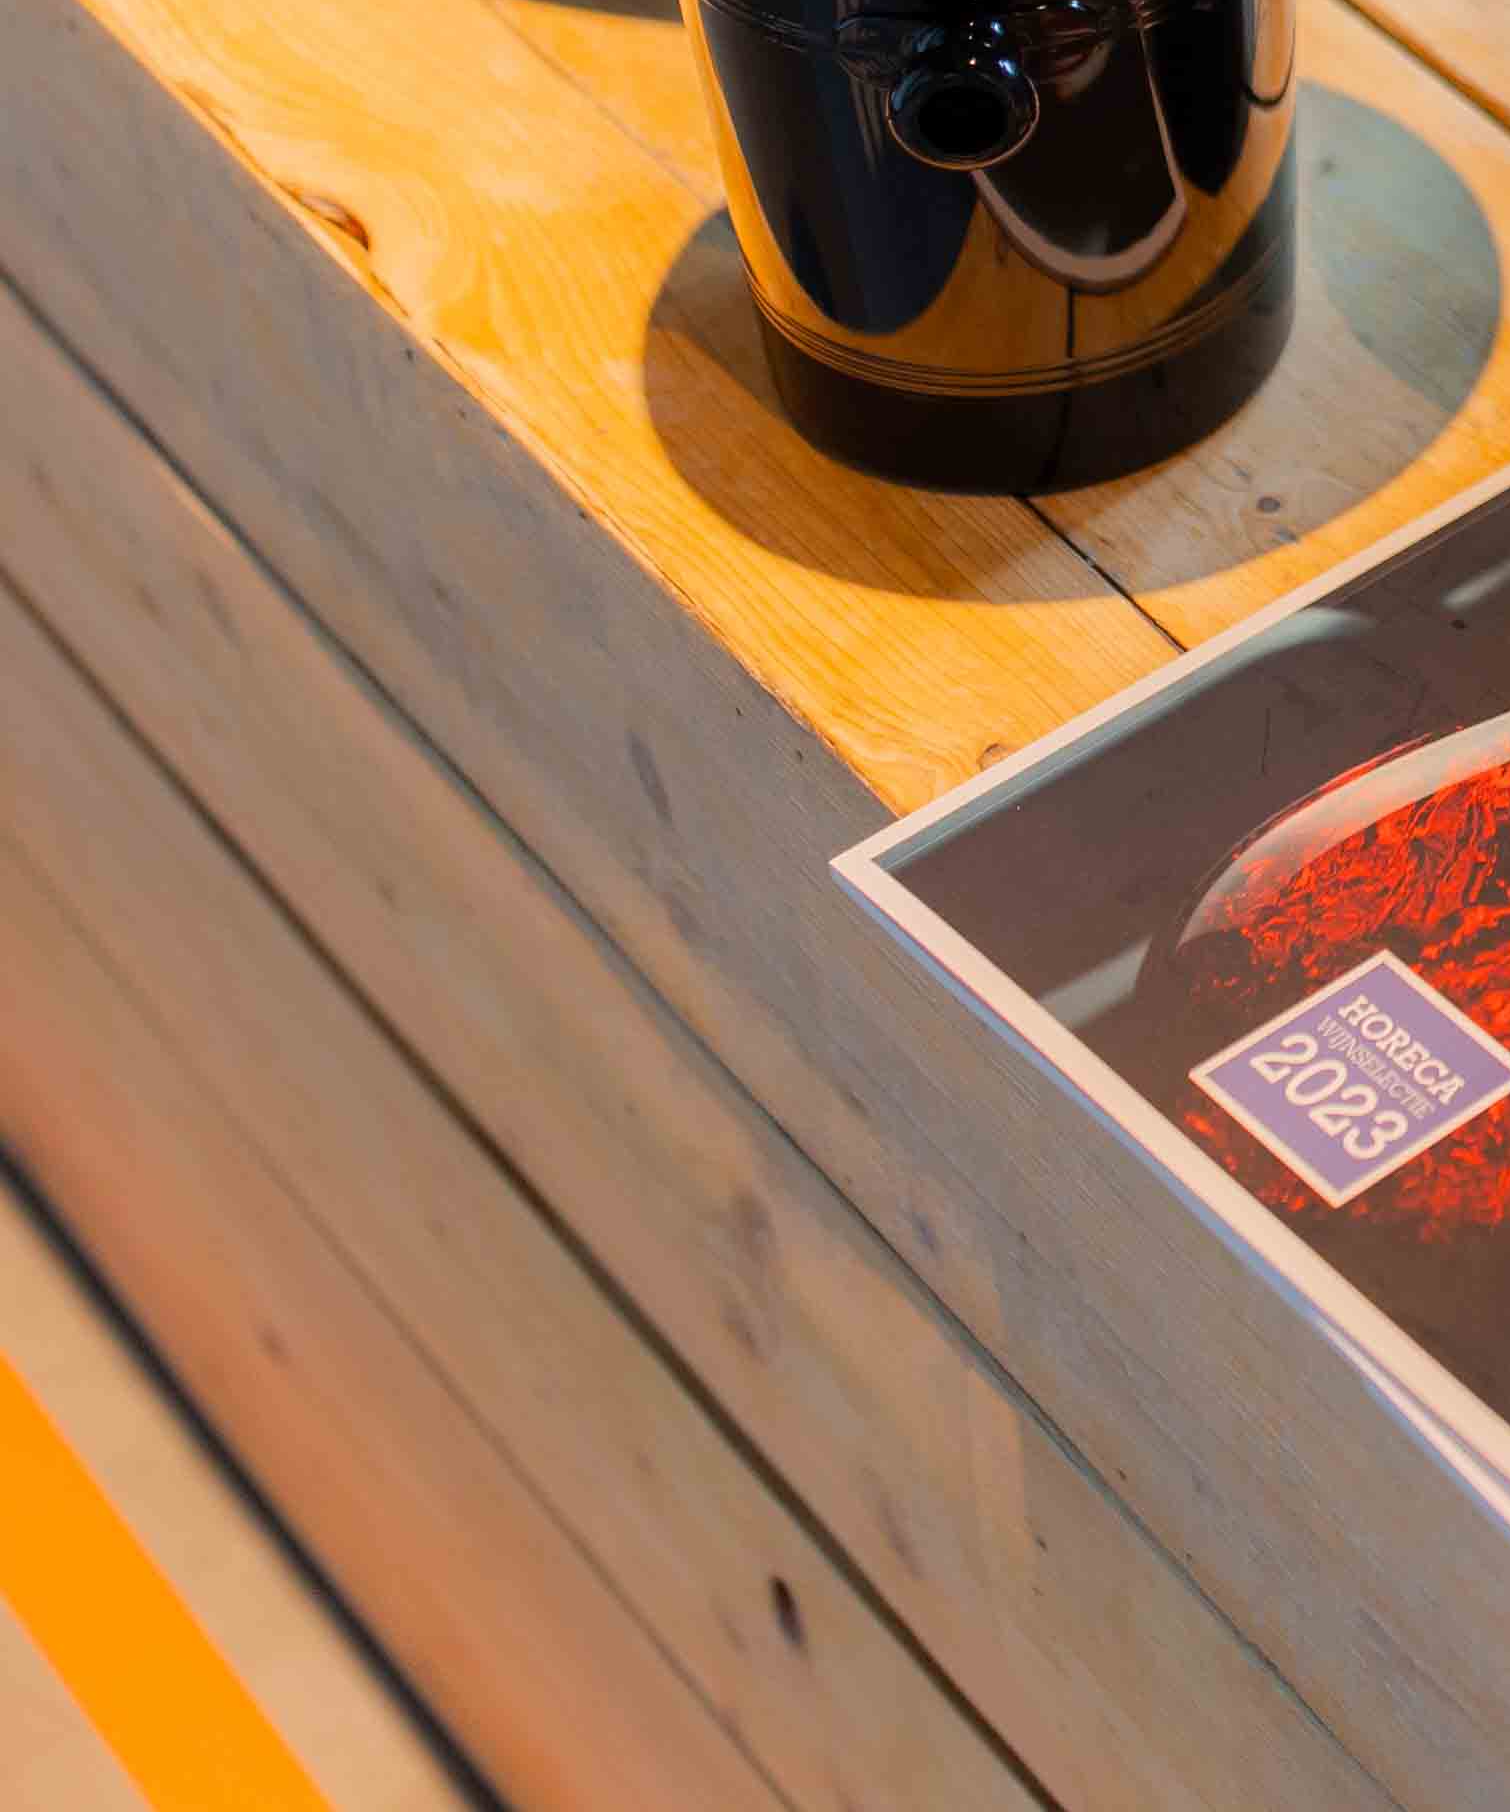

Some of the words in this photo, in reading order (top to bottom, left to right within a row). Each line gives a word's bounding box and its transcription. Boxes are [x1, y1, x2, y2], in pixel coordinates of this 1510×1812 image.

[1249, 1032, 1409, 1161] 2023
[1316, 1014, 1437, 1121] WIJNSELECTIE
[1337, 993, 1466, 1106] HORECA
